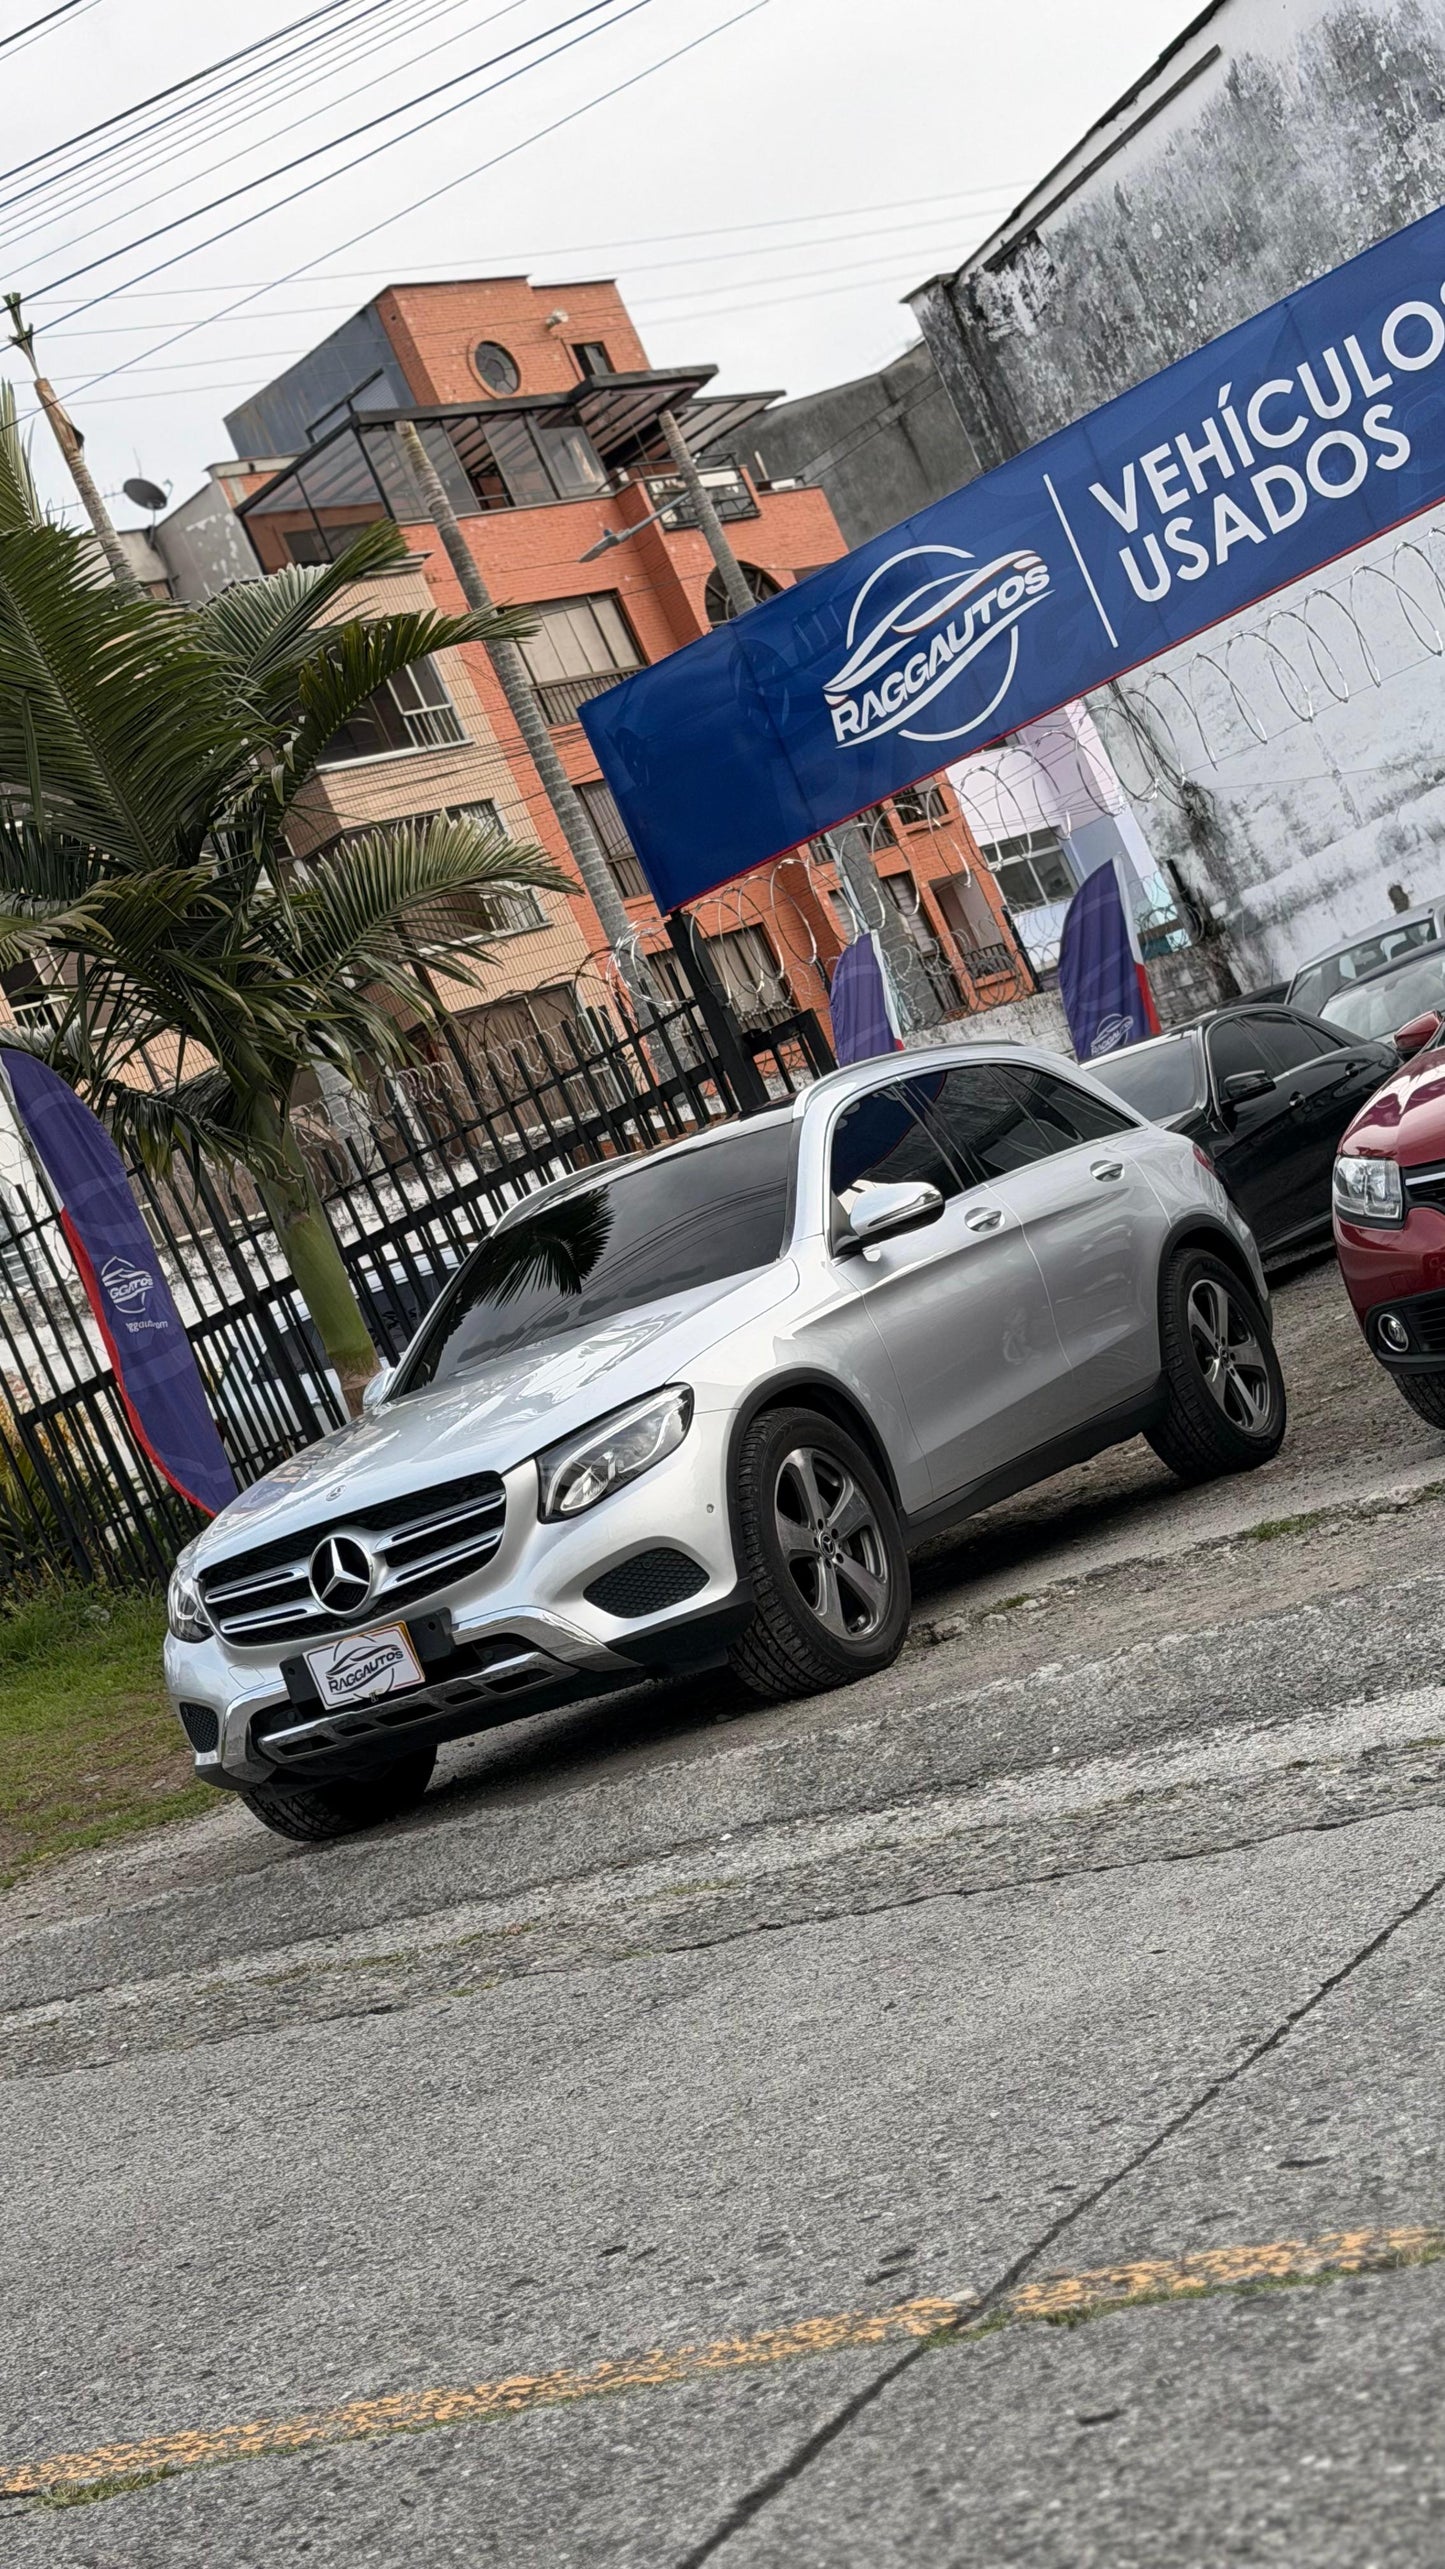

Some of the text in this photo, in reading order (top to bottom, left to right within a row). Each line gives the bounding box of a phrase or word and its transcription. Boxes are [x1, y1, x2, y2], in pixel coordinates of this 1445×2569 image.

[1089, 281, 1445, 533] VEHÍCULO
[1119, 404, 1411, 602] USADOS
[831, 565, 1050, 742] RAGGAUTOS
[328, 1650, 404, 1693] RAGGAUTOS
